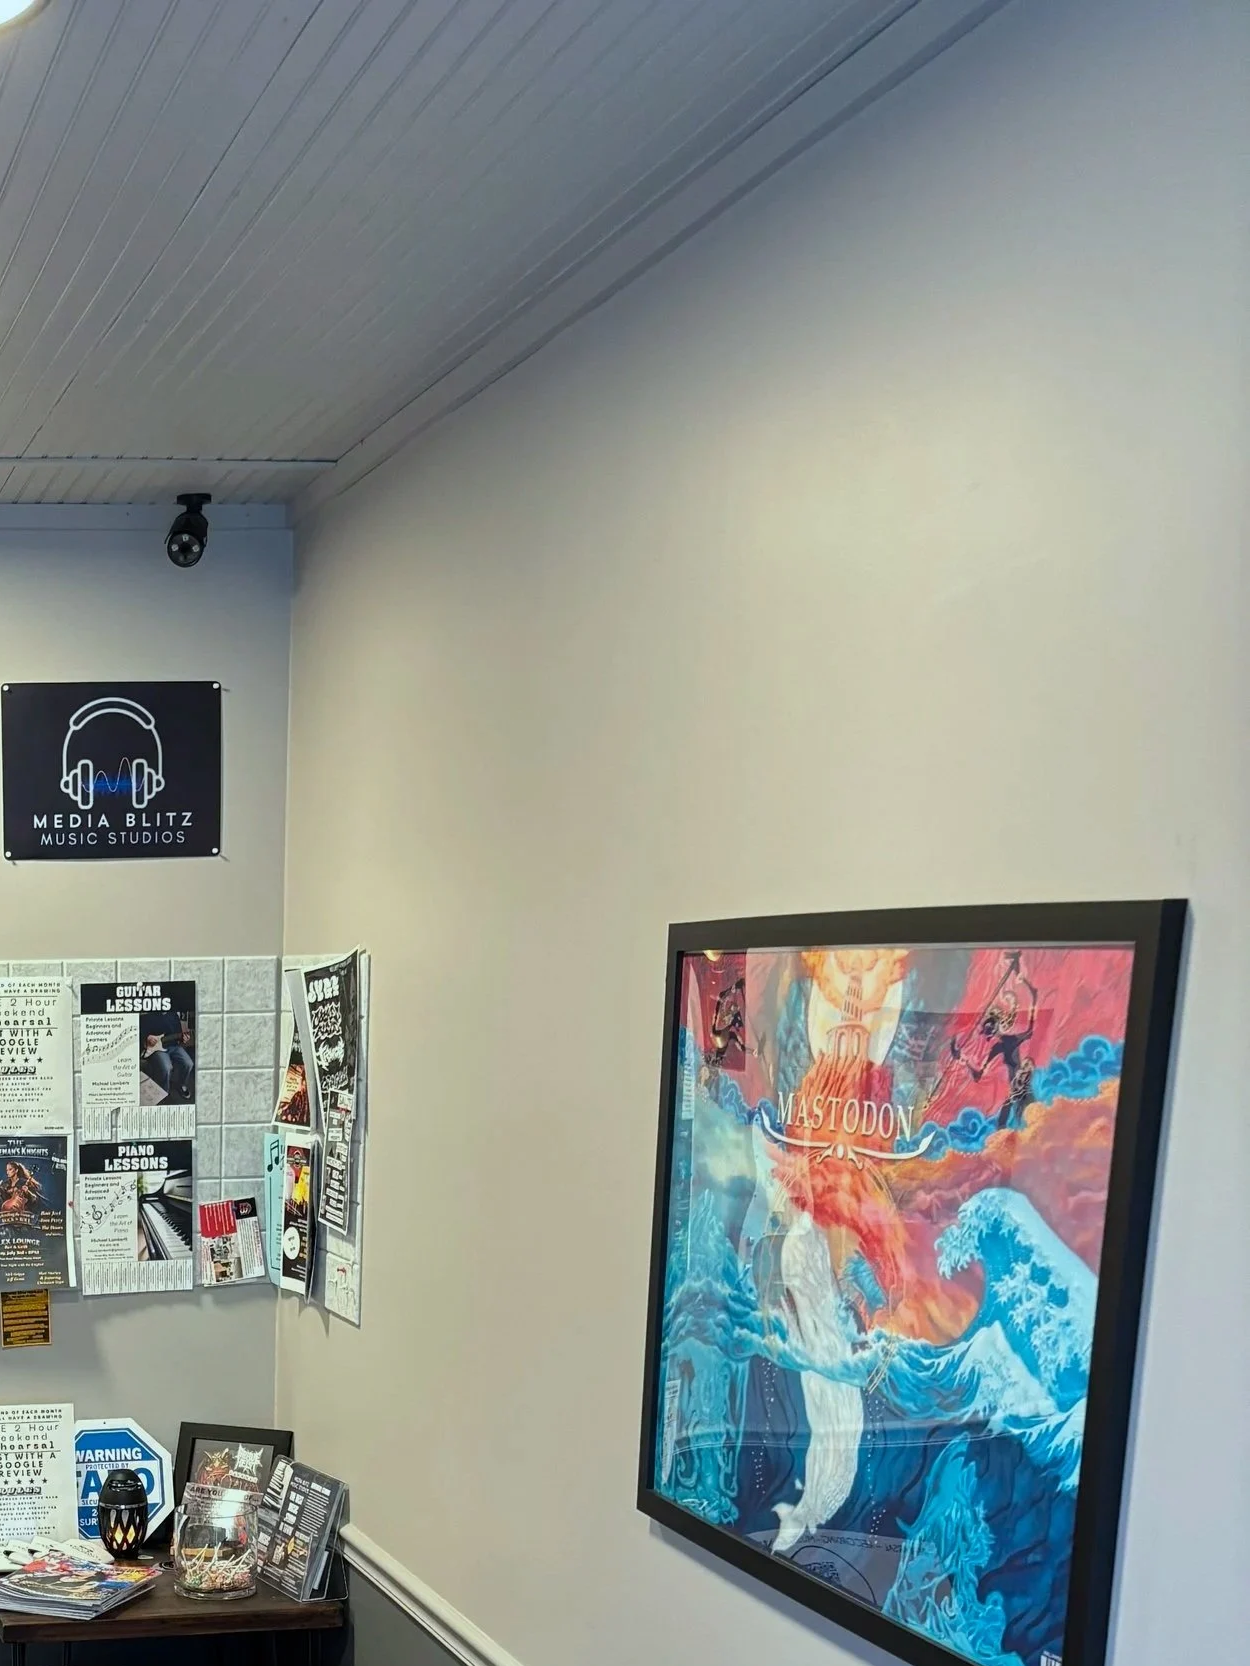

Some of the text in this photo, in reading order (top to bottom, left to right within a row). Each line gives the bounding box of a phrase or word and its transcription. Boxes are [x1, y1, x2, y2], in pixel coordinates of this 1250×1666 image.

[33, 812, 193, 829] MEDIA BLITZ
[41, 831, 185, 846] MUSIC STUDIOS
[116, 985, 161, 998] GUITAR
[10, 998, 17, 1007] 2
[25, 998, 57, 1007] Hour
[106, 998, 171, 1013] LESSONS
[777, 1091, 914, 1142] MASTODON
[118, 1145, 154, 1157] PIANO
[104, 1157, 168, 1171] LESSONS
[15, 1424, 21, 1432] 2
[29, 1424, 59, 1432] Hour
[15, 1452, 43, 1460] WITH
[76, 1447, 142, 1462] WARNING
[208, 1488, 223, 1496] YOU
[80, 1518, 98, 1526] SUR
